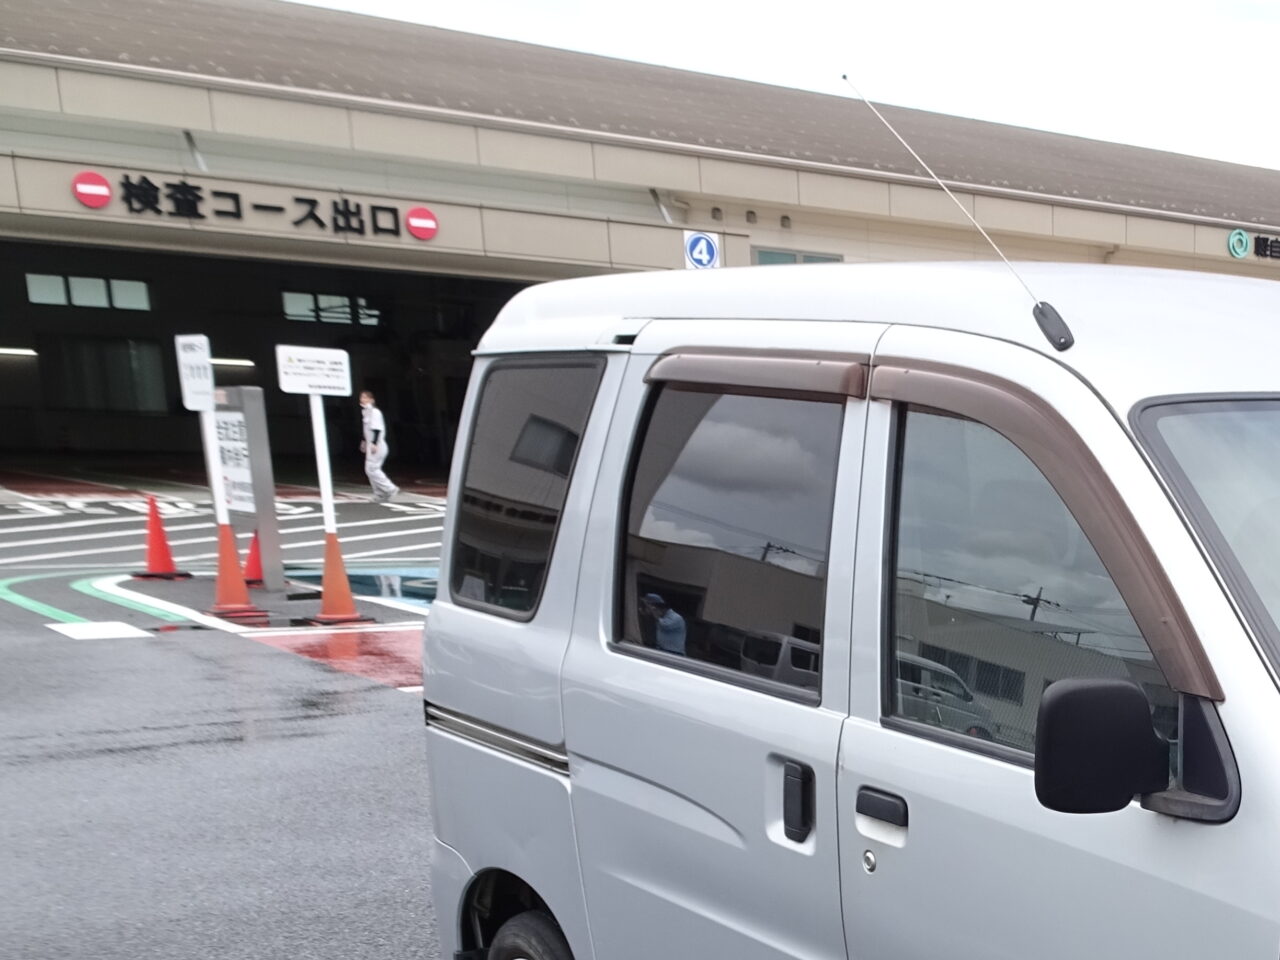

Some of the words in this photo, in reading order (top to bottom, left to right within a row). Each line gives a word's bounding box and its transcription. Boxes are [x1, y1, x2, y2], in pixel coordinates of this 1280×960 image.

[120, 174, 401, 236] 検査コース出口
[692, 238, 711, 265] 4
